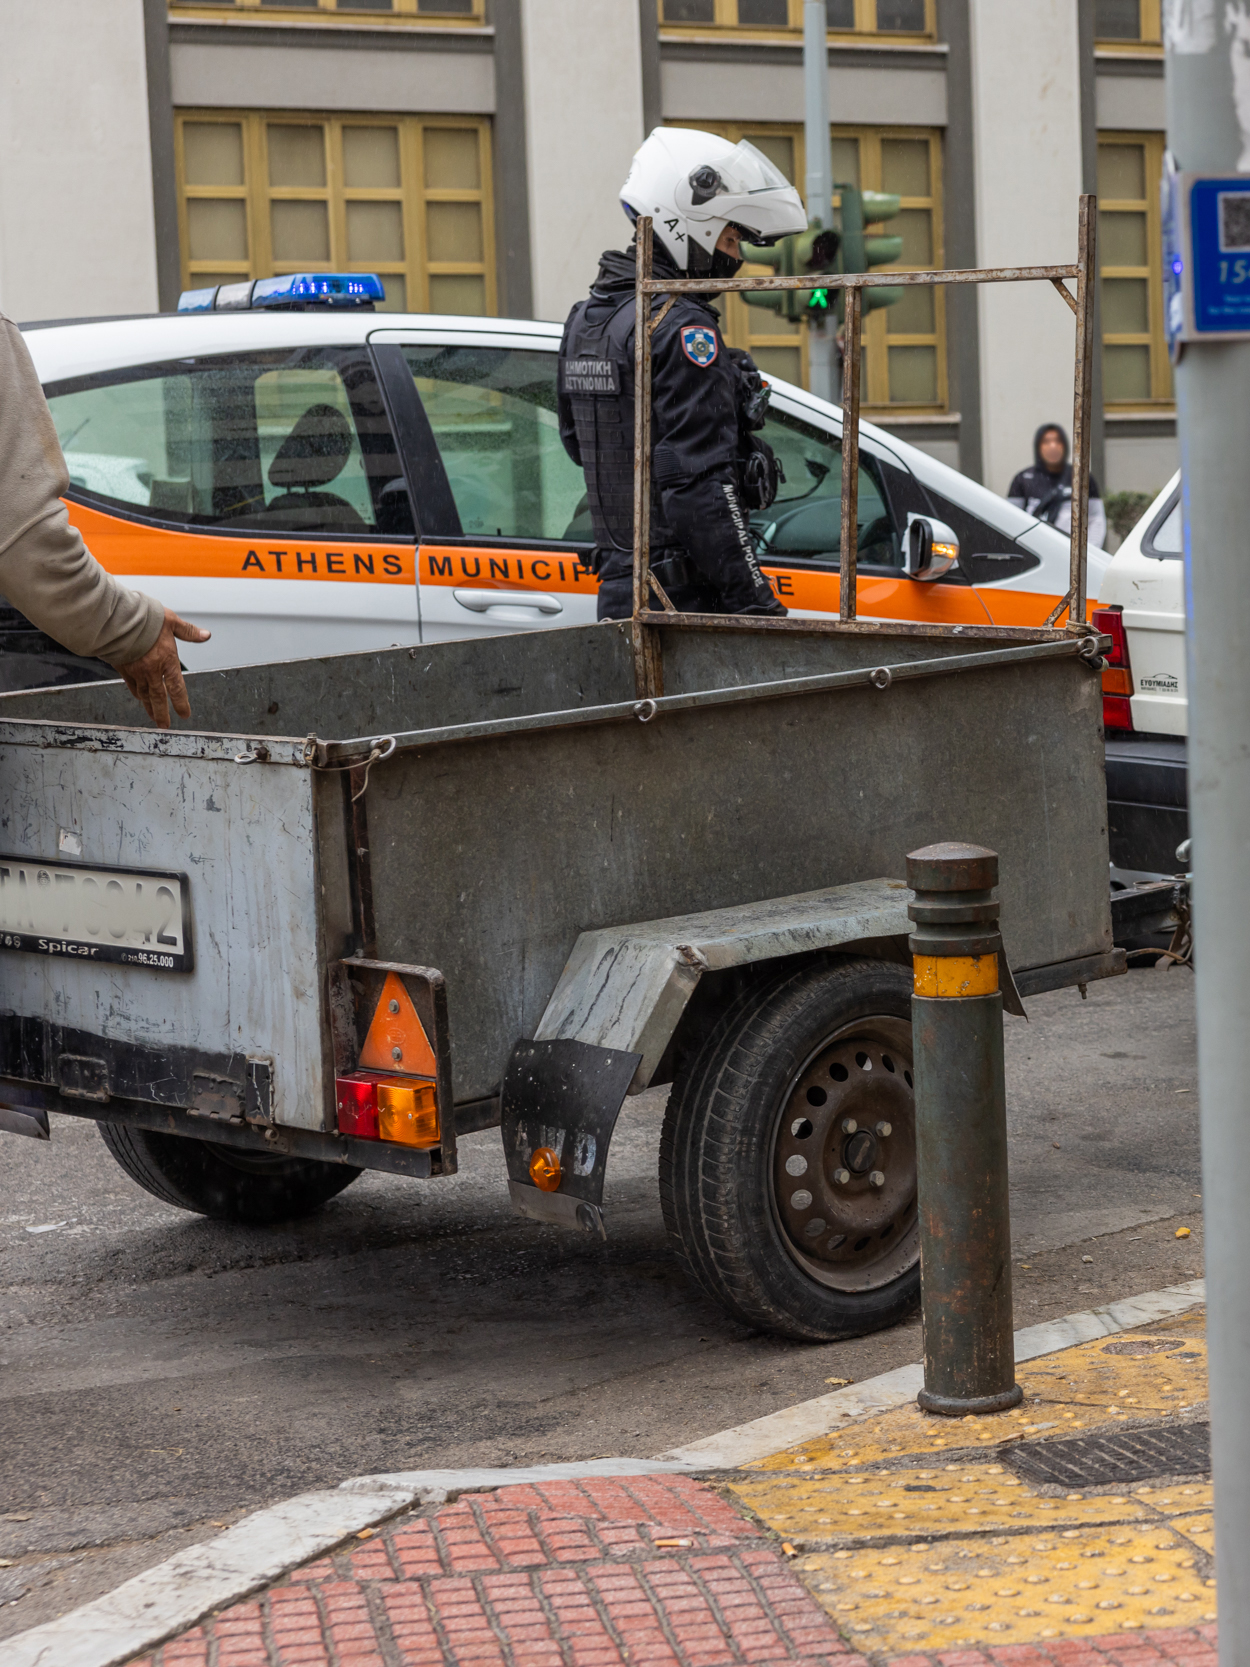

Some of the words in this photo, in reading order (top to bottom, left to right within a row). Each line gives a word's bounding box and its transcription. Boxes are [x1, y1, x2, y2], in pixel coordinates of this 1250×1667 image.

[565, 361, 612, 375] ΔΗΜΟΤΙΚΗ
[565, 376, 616, 391] ΑΣΤΥΝΟΜΙΑ
[722, 484, 749, 546] MUNICIPAL
[742, 545, 764, 587] POLICE
[241, 550, 403, 575] ATHENS
[428, 555, 604, 583] MUNICIP
[38, 939, 99, 956] Spicar
